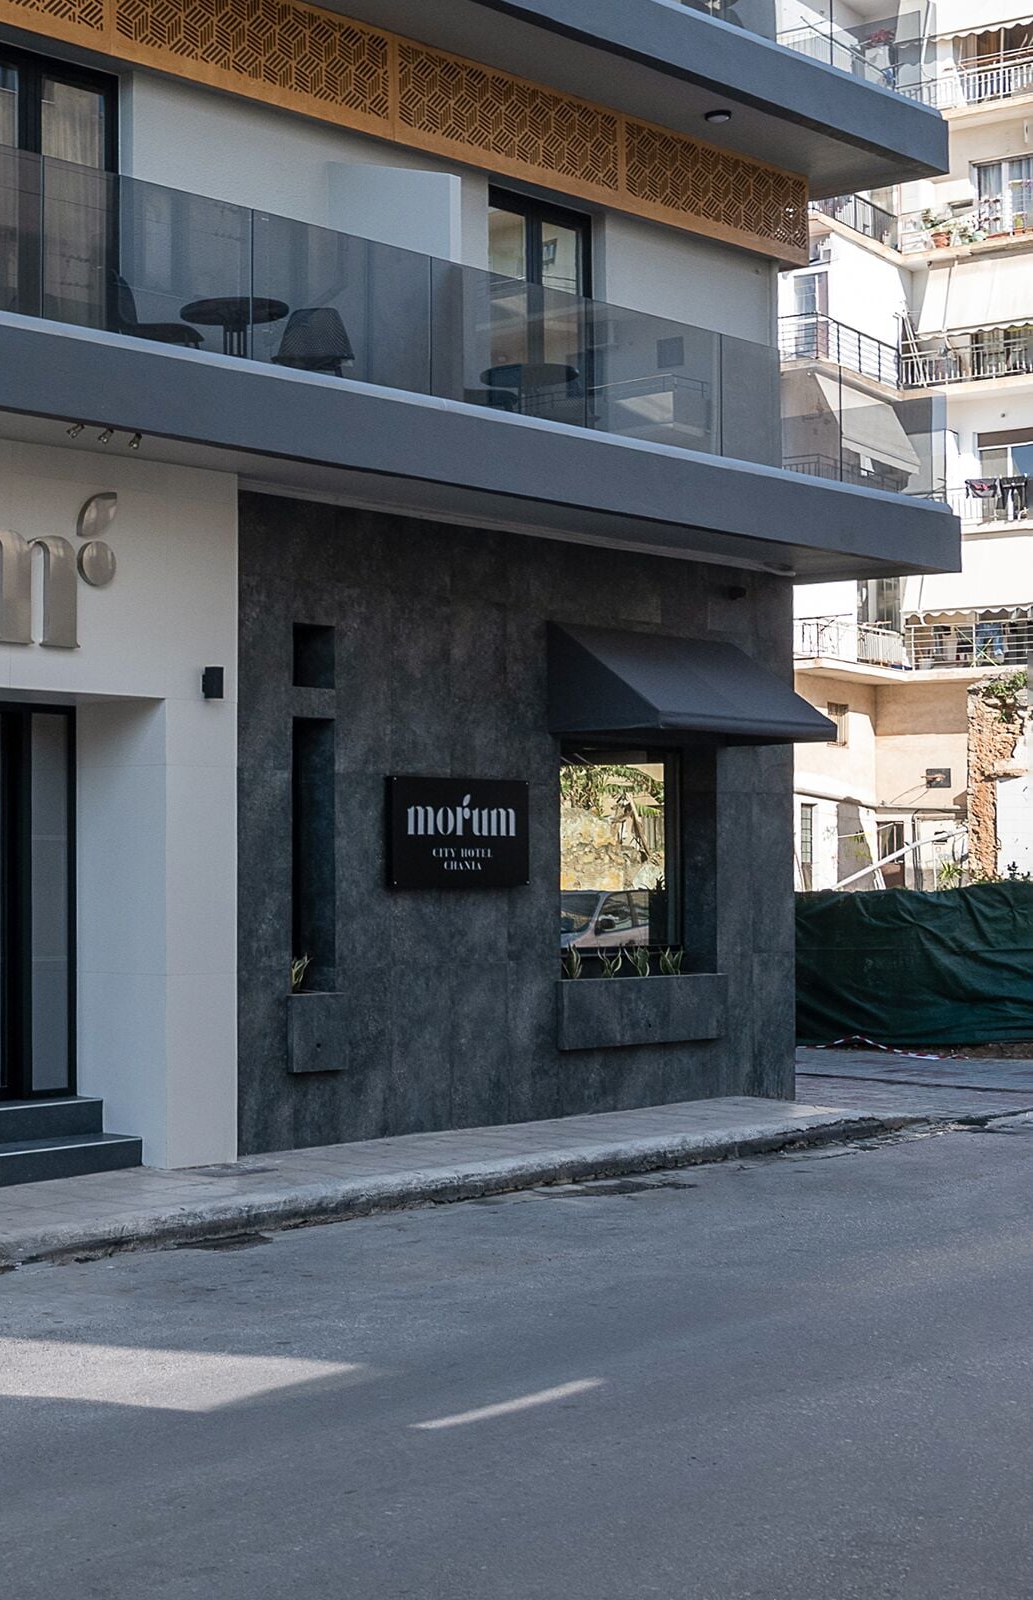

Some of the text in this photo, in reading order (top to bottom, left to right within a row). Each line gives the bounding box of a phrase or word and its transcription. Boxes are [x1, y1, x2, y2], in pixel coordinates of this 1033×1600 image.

[432, 848, 493, 858] CITY HOTEL
[443, 860, 482, 871] CHANIA
